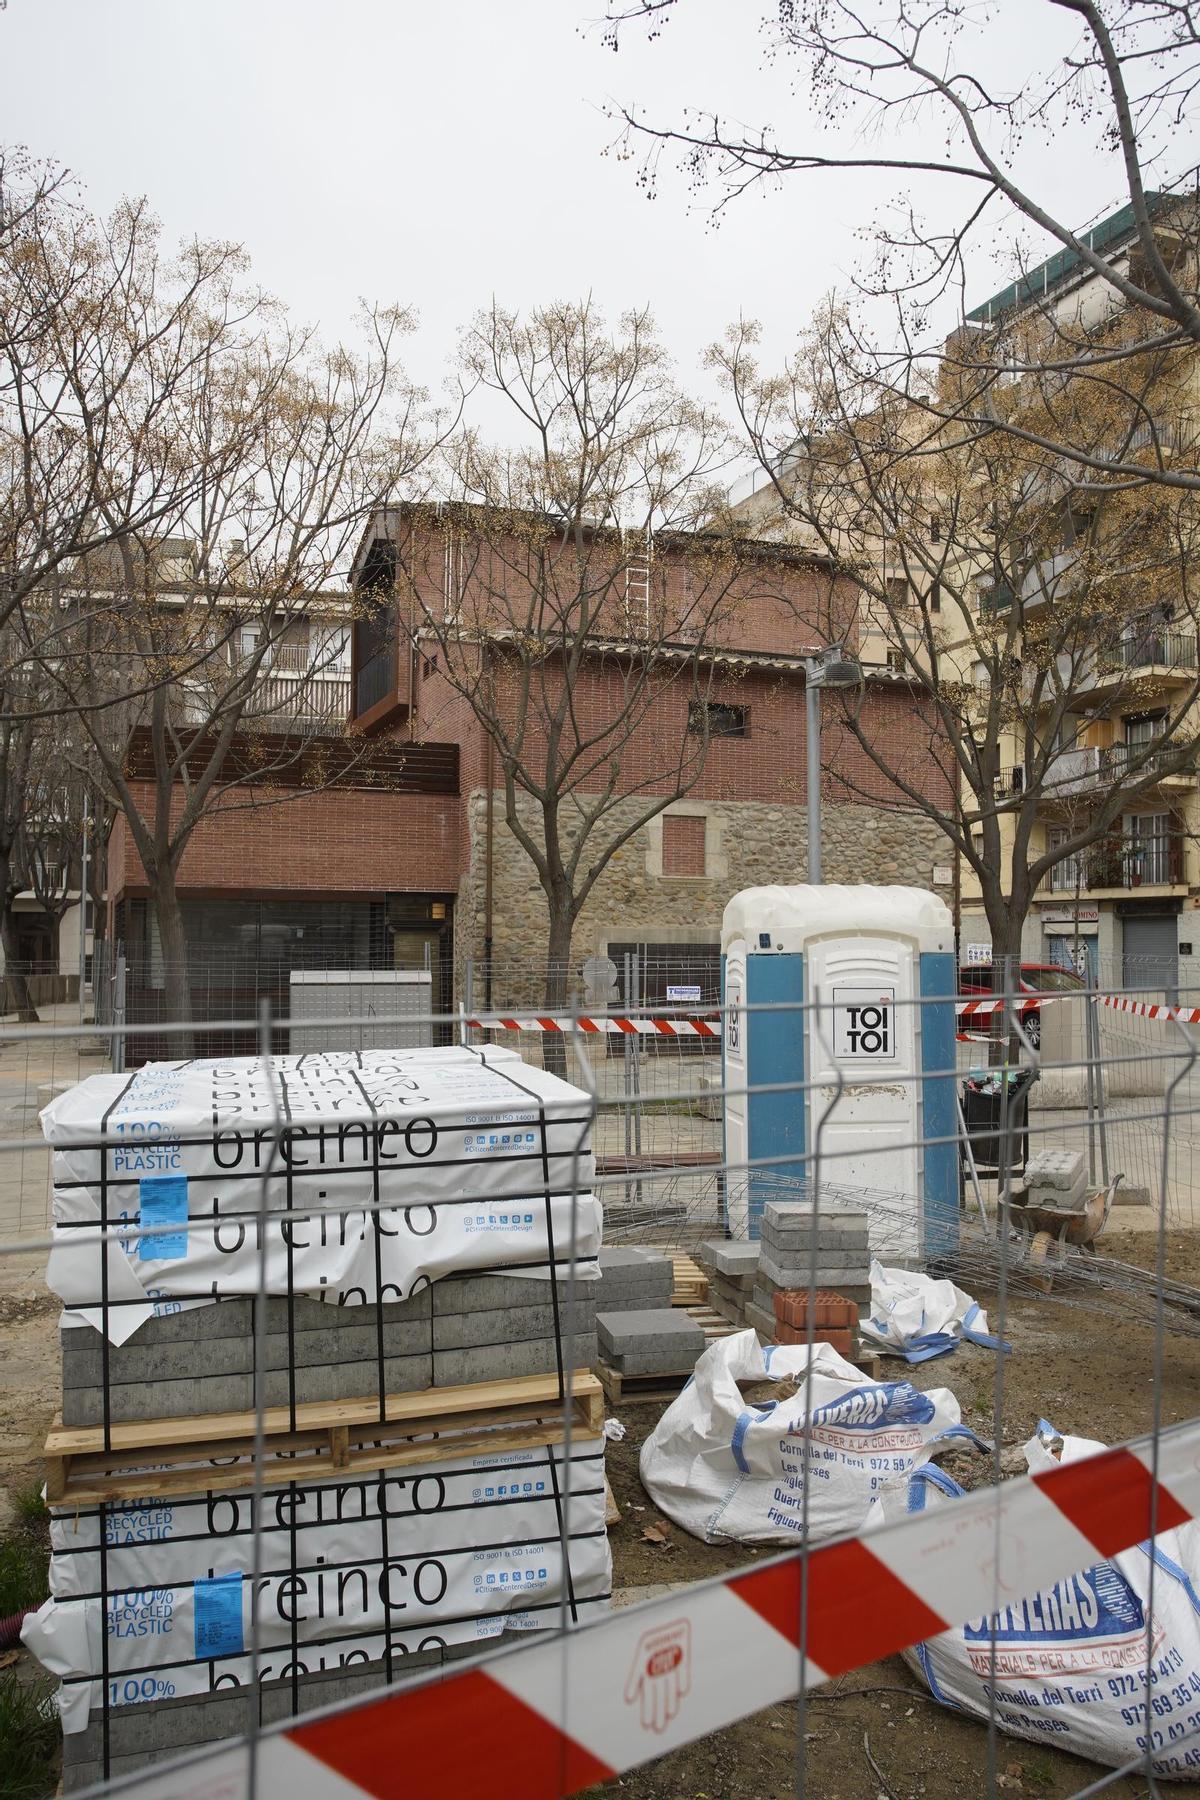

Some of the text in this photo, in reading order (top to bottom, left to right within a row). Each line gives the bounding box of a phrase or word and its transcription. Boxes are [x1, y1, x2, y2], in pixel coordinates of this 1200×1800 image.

[1071, 911, 1098, 919] DOMINO
[846, 1006, 888, 1030] TOI
[728, 1025, 739, 1047] TOI
[846, 1030, 889, 1053] TOI
[115, 1121, 181, 1142] 100%
[114, 1154, 181, 1171] PLASTIC
[828, 1434, 845, 1448] PER
[849, 1438, 855, 1449] A
[857, 1438, 870, 1450] LA
[472, 1453, 533, 1467] Empresa certificada
[823, 1448, 837, 1462] del
[842, 1453, 864, 1470] Terri
[870, 1458, 890, 1471] 972
[893, 1459, 904, 1471] 59
[781, 1460, 830, 1480] Les Peses
[782, 1475, 807, 1491] ngle
[773, 1487, 802, 1511] Quart
[105, 1513, 173, 1531] RECYCLED
[767, 1507, 810, 1534] Figueres
[105, 1526, 173, 1546] PLASTIC
[473, 1553, 485, 1561] ISO
[486, 1551, 502, 1560] 9001
[512, 1548, 523, 1557] ISO
[525, 1546, 544, 1555] 14001
[109, 1586, 174, 1611] 100%
[207, 1556, 448, 1627] reinco
[107, 1604, 173, 1624] RECYCLED
[520, 1619, 539, 1627] 14001
[107, 1618, 173, 1638] PLASTIC
[476, 1625, 503, 1637] ISO 900
[969, 1653, 1037, 1674] MATERIALS
[1040, 1656, 1065, 1671] PER
[1069, 1654, 1079, 1667] A
[1083, 1653, 1097, 1666] LA
[983, 1646, 1184, 1707] Cornella del Terri 972 59 41 31
[109, 1677, 176, 1703] 100%
[996, 1707, 1022, 1727] Les
[1024, 1714, 1071, 1732] Preses
[1120, 1703, 1153, 1726] 972
[1151, 1694, 1174, 1717] 69
[1171, 1683, 1193, 1707] 35
[1151, 1757, 1186, 1775] 972
